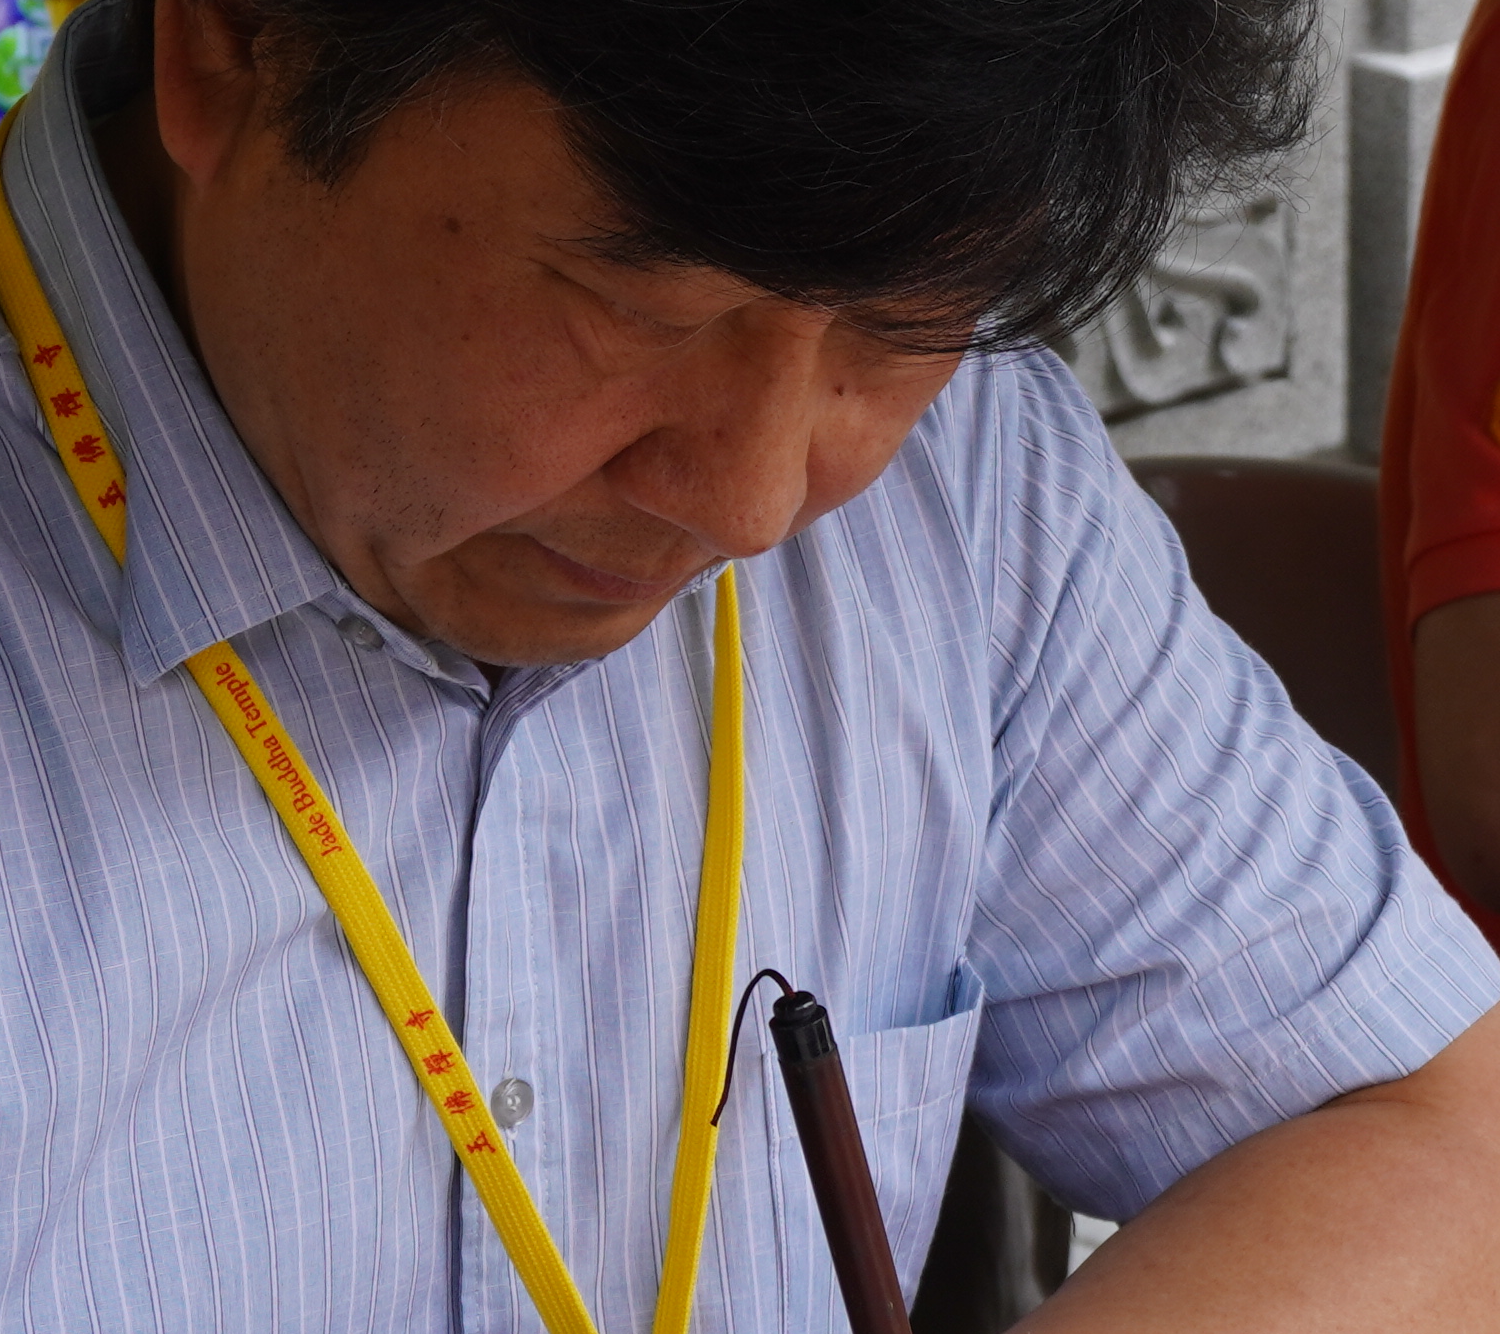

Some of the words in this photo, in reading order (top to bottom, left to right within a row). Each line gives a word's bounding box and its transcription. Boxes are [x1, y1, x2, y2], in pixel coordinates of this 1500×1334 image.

[215, 662, 267, 740] Temple
[263, 733, 316, 813] Buddha
[308, 811, 343, 857] Jade
